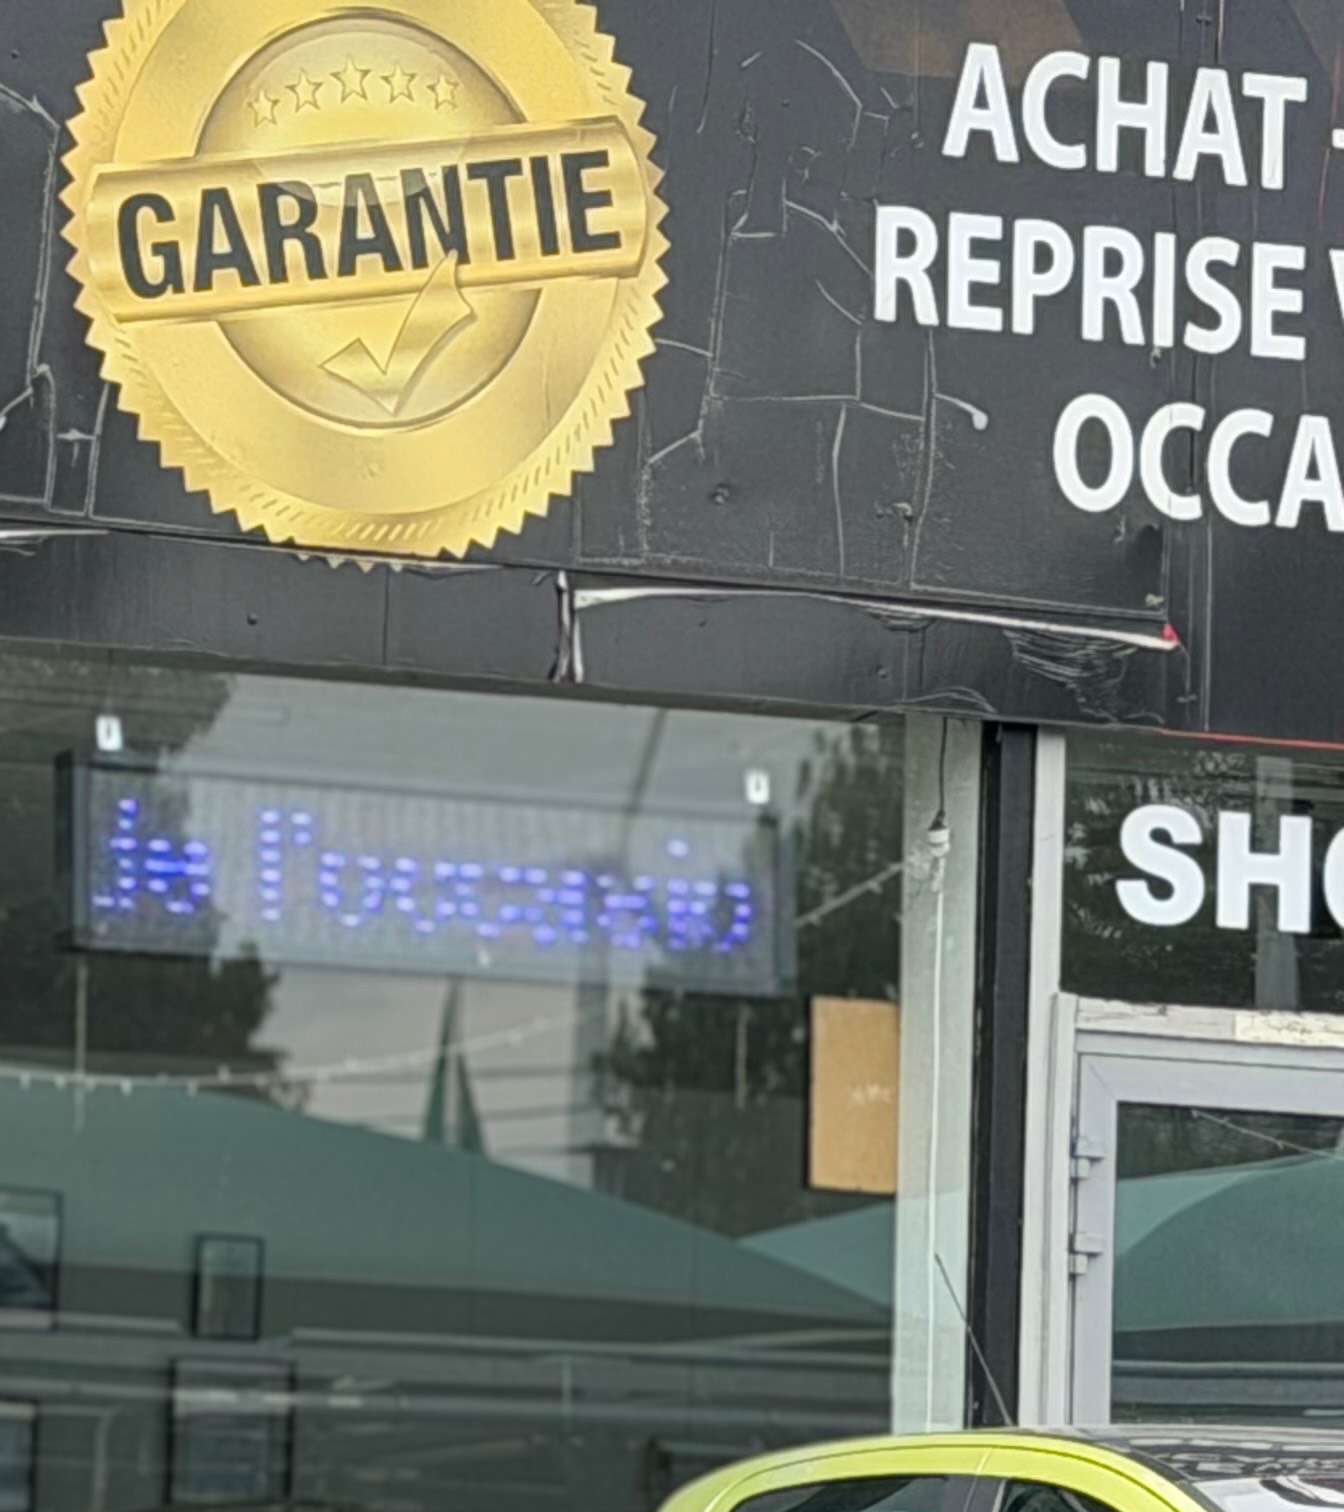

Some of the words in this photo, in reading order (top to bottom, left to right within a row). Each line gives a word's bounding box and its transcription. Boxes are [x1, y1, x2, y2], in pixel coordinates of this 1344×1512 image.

[942, 42, 1308, 190] ACHAT
[116, 149, 622, 300] GARANTIE
[874, 205, 1307, 361] REPRISE
[1053, 393, 1344, 532] OCCA
[1114, 803, 1344, 934] SH
